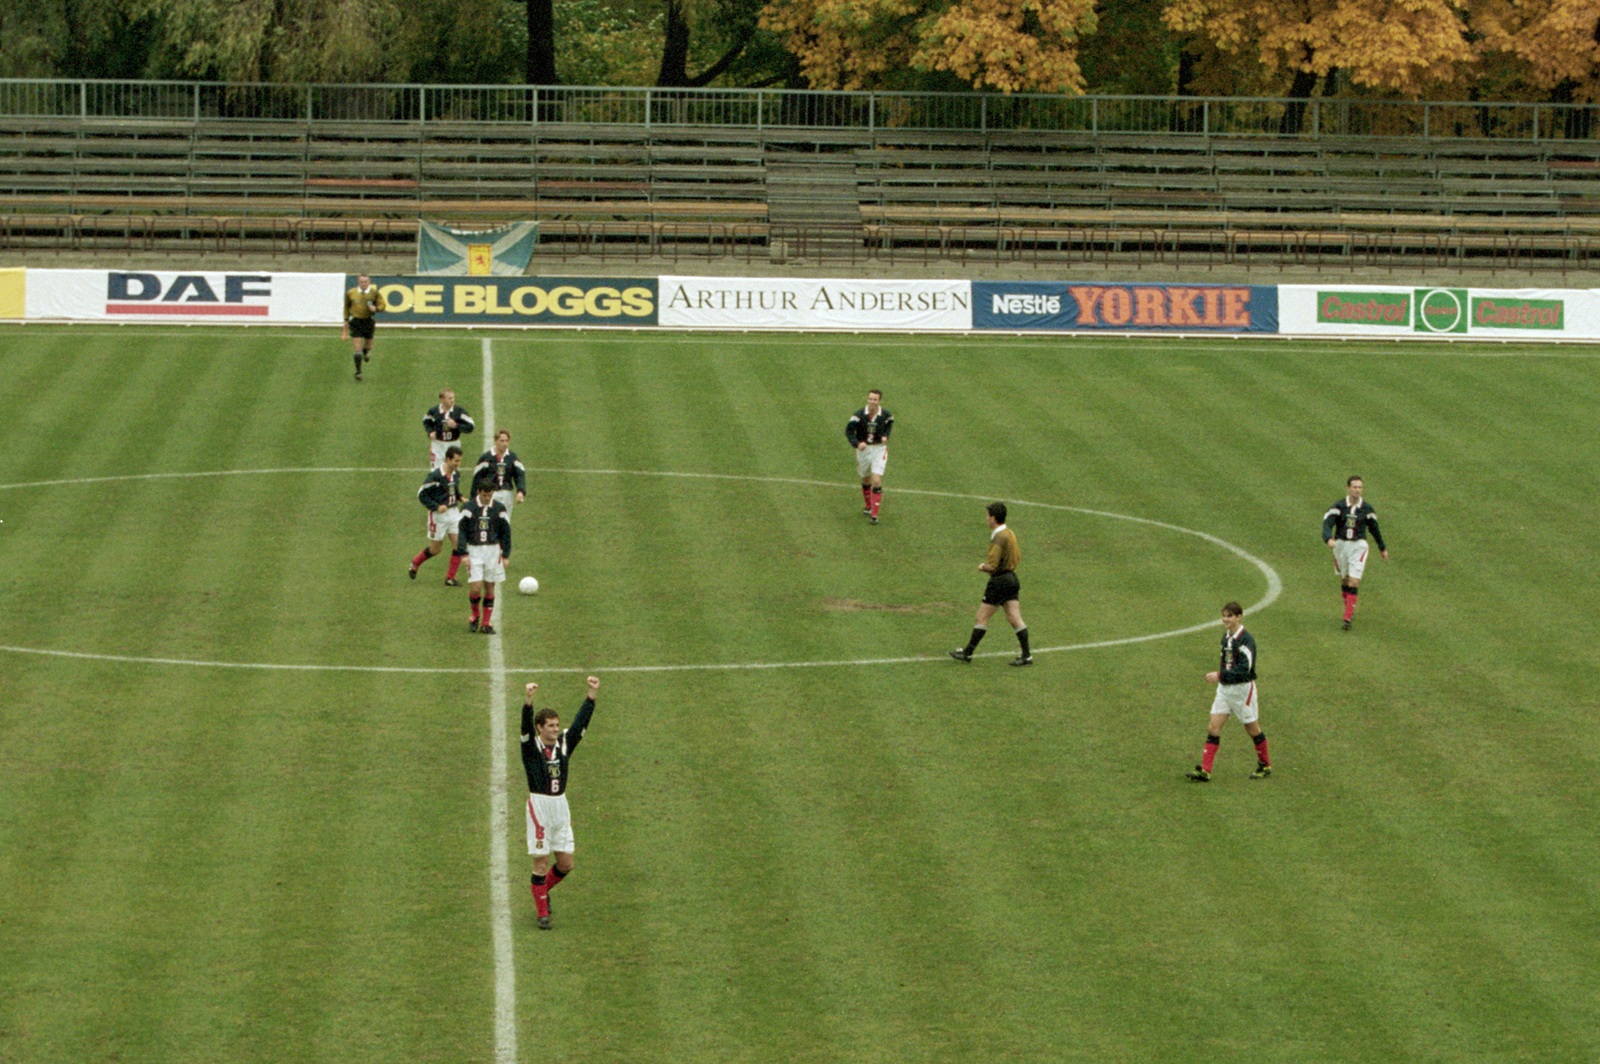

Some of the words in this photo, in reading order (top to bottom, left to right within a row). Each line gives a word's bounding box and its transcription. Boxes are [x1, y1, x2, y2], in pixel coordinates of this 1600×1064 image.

[108, 272, 271, 302] DAF
[371, 284, 444, 314] OE
[454, 285, 654, 317] BLOGGS
[1069, 286, 1249, 326] YORKIE
[1321, 295, 1407, 323] Castrol
[1475, 301, 1561, 326] Castrol
[480, 530, 487, 542] 9
[550, 779, 560, 793] 6
